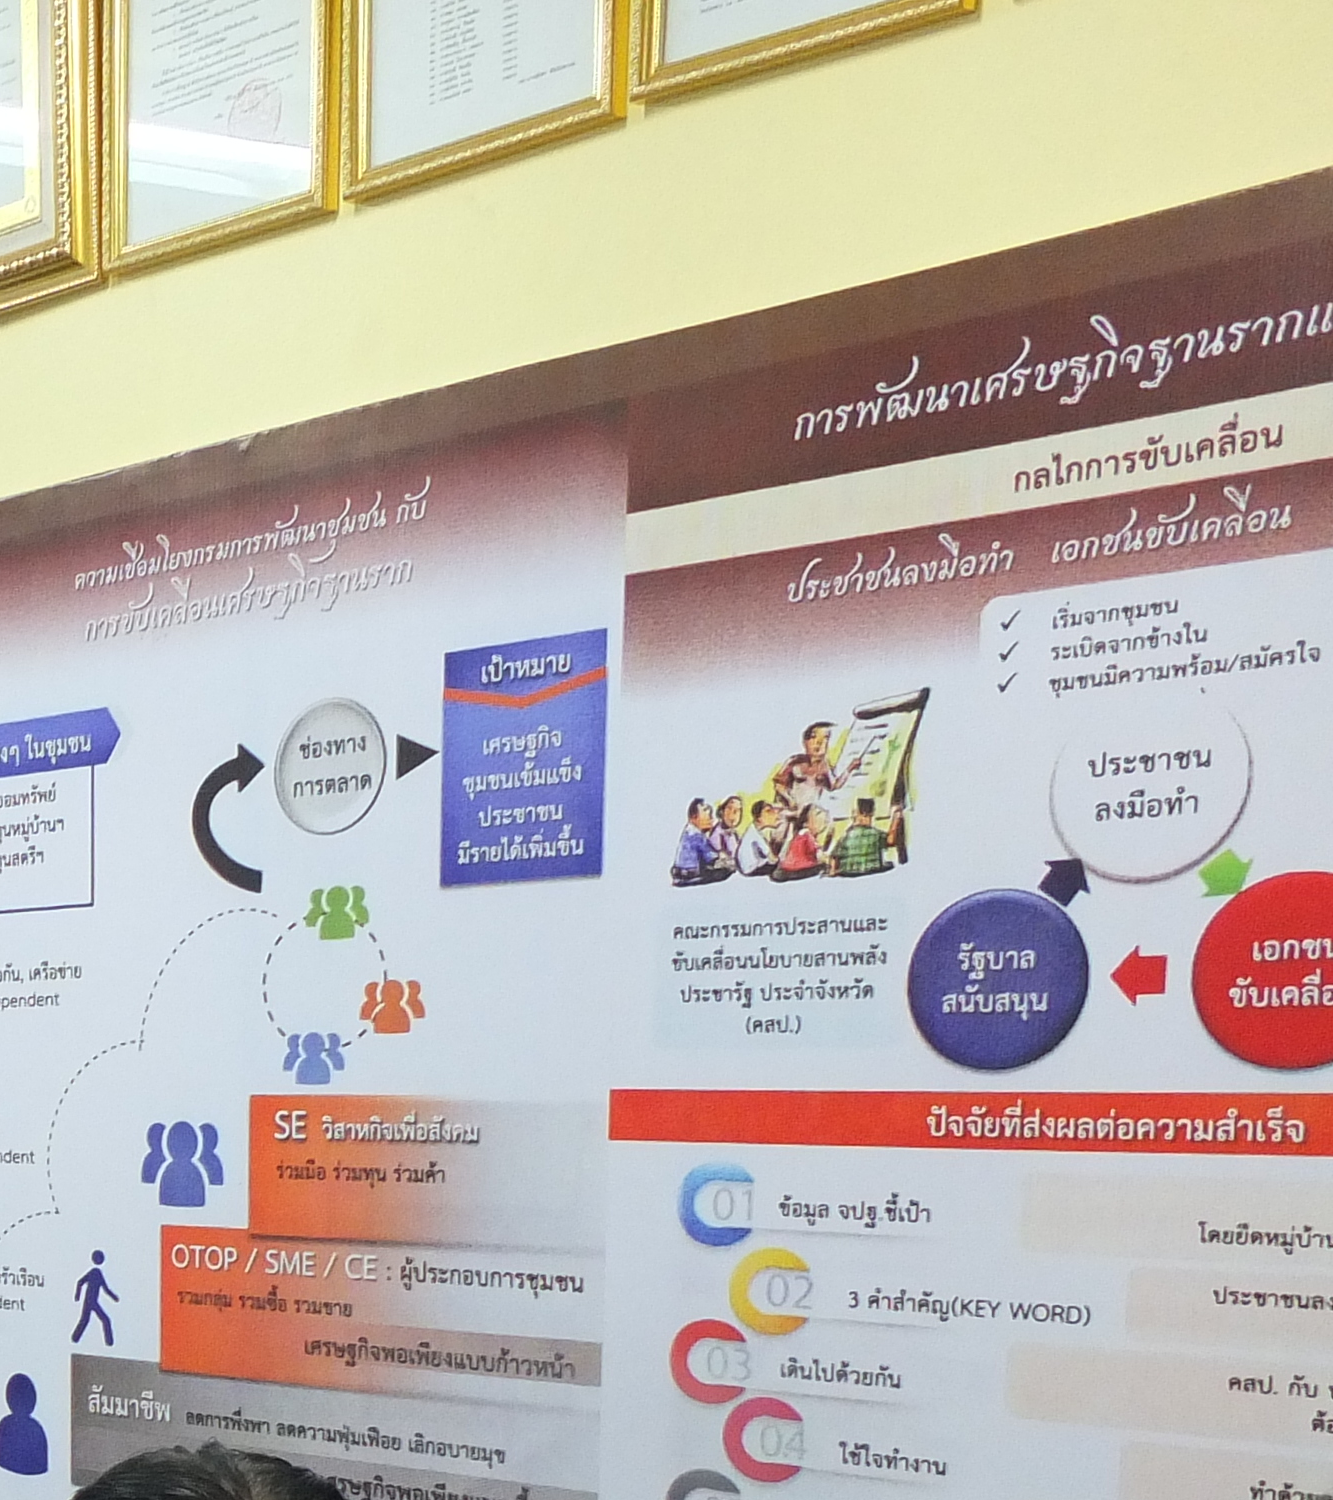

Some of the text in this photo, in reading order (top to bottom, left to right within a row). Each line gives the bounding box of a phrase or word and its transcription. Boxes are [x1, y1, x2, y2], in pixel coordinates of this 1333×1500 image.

[1013, 413, 1285, 494] กลไกการขับเคลื่อน
[74, 476, 432, 590] ความเชื่อมโยงกรมการพัฒนาชุมชน กับ
[787, 483, 1293, 604] ประชาชนลงมือทำ เอกชนขับเคลื่อน
[84, 555, 413, 642] การขับเคลื่อนเศรษฐกิจฐานราก
[1051, 599, 1179, 630] เริ่มจากชุมชน
[1049, 621, 1209, 663] ระเบิดจากข้างใน
[480, 651, 572, 686] เป้าหมาย
[1047, 640, 1321, 700] ชุมชนมีความพร้อม/สมัครใจ
[24, 732, 92, 768] ในชุมชน
[298, 734, 368, 763] ช่องทาง
[482, 725, 564, 758] เศรษฐกิจ
[461, 757, 583, 800] ชุมชนเข้มแข็ง
[1087, 745, 1213, 780] ประชาชน
[292, 772, 373, 800] การตลาด
[478, 803, 564, 830] ประชาชน
[1093, 787, 1199, 824] ลงมือทำ
[456, 824, 585, 867] มีรายได้เพิ่มขึ้น
[671, 915, 889, 941] คณะกรรมการประสานและ
[28, 959, 82, 983] เครือข่าย
[670, 944, 889, 973] ขับเคลื่อนนโยบายสานพลัง
[956, 943, 1038, 979] รัฐบาล
[679, 979, 875, 1009] ประชารัฐ ประจำจังหวัด
[940, 984, 1050, 1022] สนับสนุน
[744, 1014, 803, 1038] (คสป.)
[273, 1111, 480, 1146] SE วิสาหกิจเพื่อสังคม
[925, 1099, 1306, 1145] ปัจจัยที่ส่งผลต่อความสำเร็จ
[712, 1187, 756, 1222] 01
[778, 1194, 830, 1227] ข้อมูล
[170, 1245, 585, 1299] OTOP SME CE ผู้ประกอบการชุมชน
[765, 1273, 815, 1311] 02
[848, 1290, 860, 1310] 3
[1009, 1301, 1091, 1328] WORD)
[303, 1336, 577, 1380] เศรษฐกิจพอเพียงแบบก้าวหน้า
[706, 1346, 752, 1382] 03
[779, 1356, 902, 1390] เดินไปด้วยกัน
[1287, 1374, 1319, 1399] กับ
[87, 1389, 171, 1423] สัมมาชีพ
[407, 1434, 506, 1467] เลิกอบายมุข
[758, 1423, 808, 1460] 04
[838, 1440, 947, 1477] ใช้ใจทำงาน
